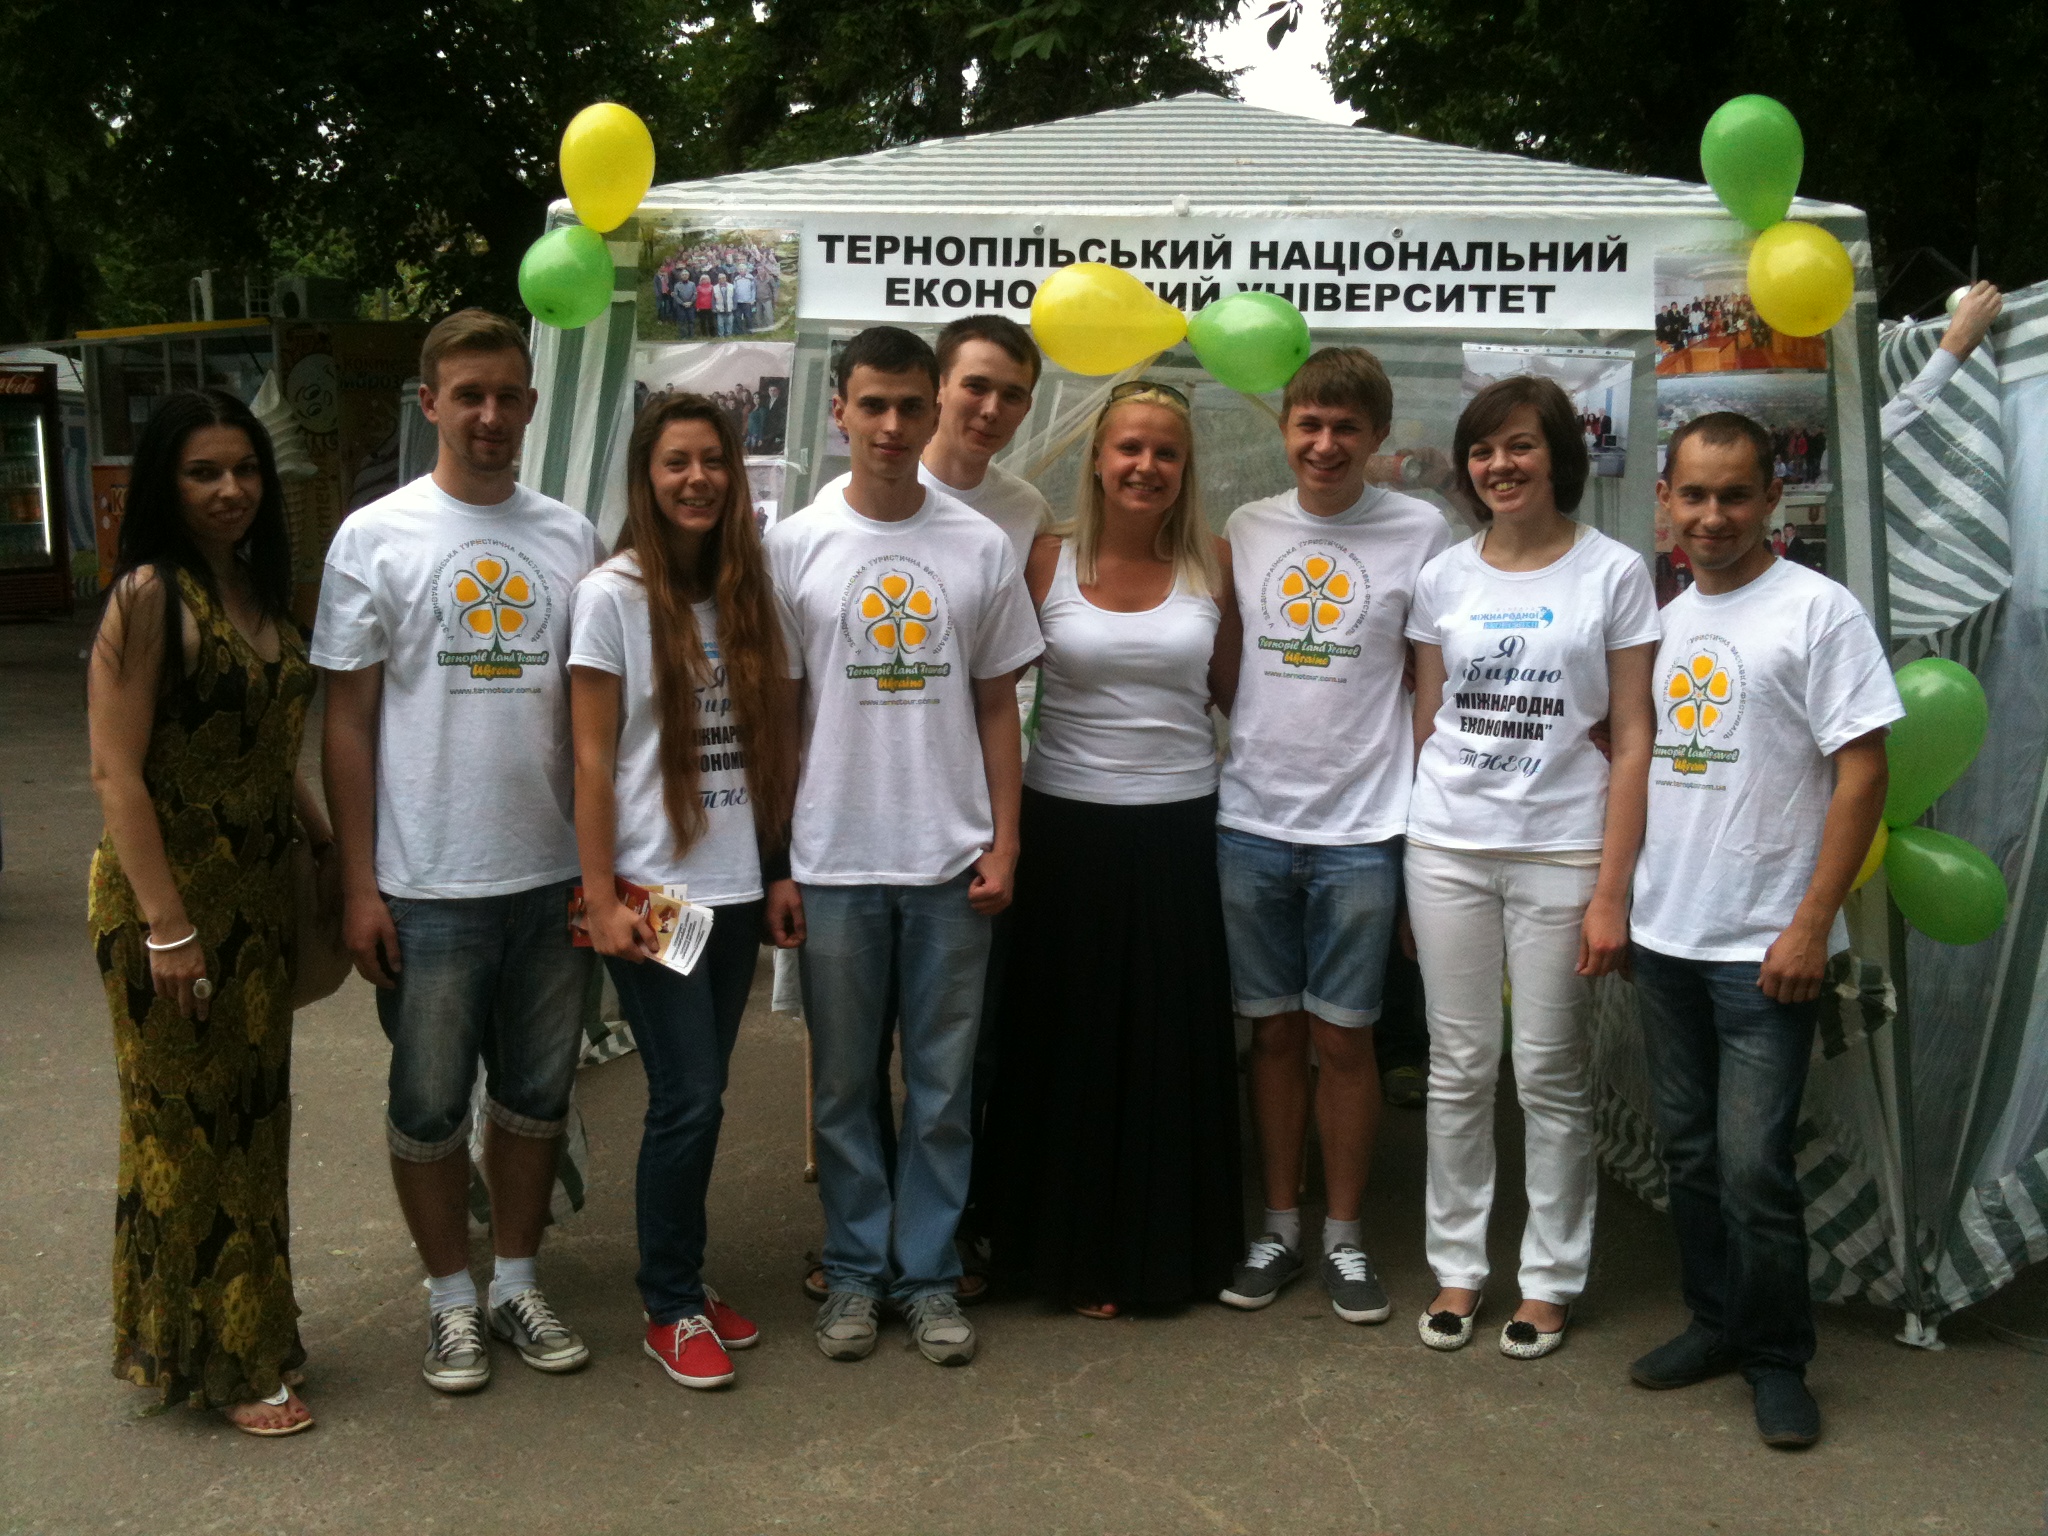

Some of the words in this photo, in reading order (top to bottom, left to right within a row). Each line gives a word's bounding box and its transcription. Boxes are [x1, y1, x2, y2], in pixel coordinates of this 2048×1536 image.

[818, 233, 1232, 269] ТЕРНОПІЛЬСЬКИЙ
[1250, 235, 1628, 276] НАЦІОНАЛЬНИЙ
[886, 275, 1220, 311] ЕКОНОИЙ
[868, 554, 921, 567] ТУРИСТИЧНА
[1260, 638, 1300, 650] Ternopil
[1301, 641, 1326, 652] Land
[1327, 644, 1359, 656] Travel
[1492, 635, 1525, 658] Я
[440, 651, 488, 664] Ternopil
[491, 652, 515, 662] Land
[516, 652, 548, 662] Travel
[848, 665, 891, 677] Ternopil
[893, 666, 918, 675] Land
[920, 665, 948, 675] Travel
[1459, 748, 1542, 778] ТНЕУ
